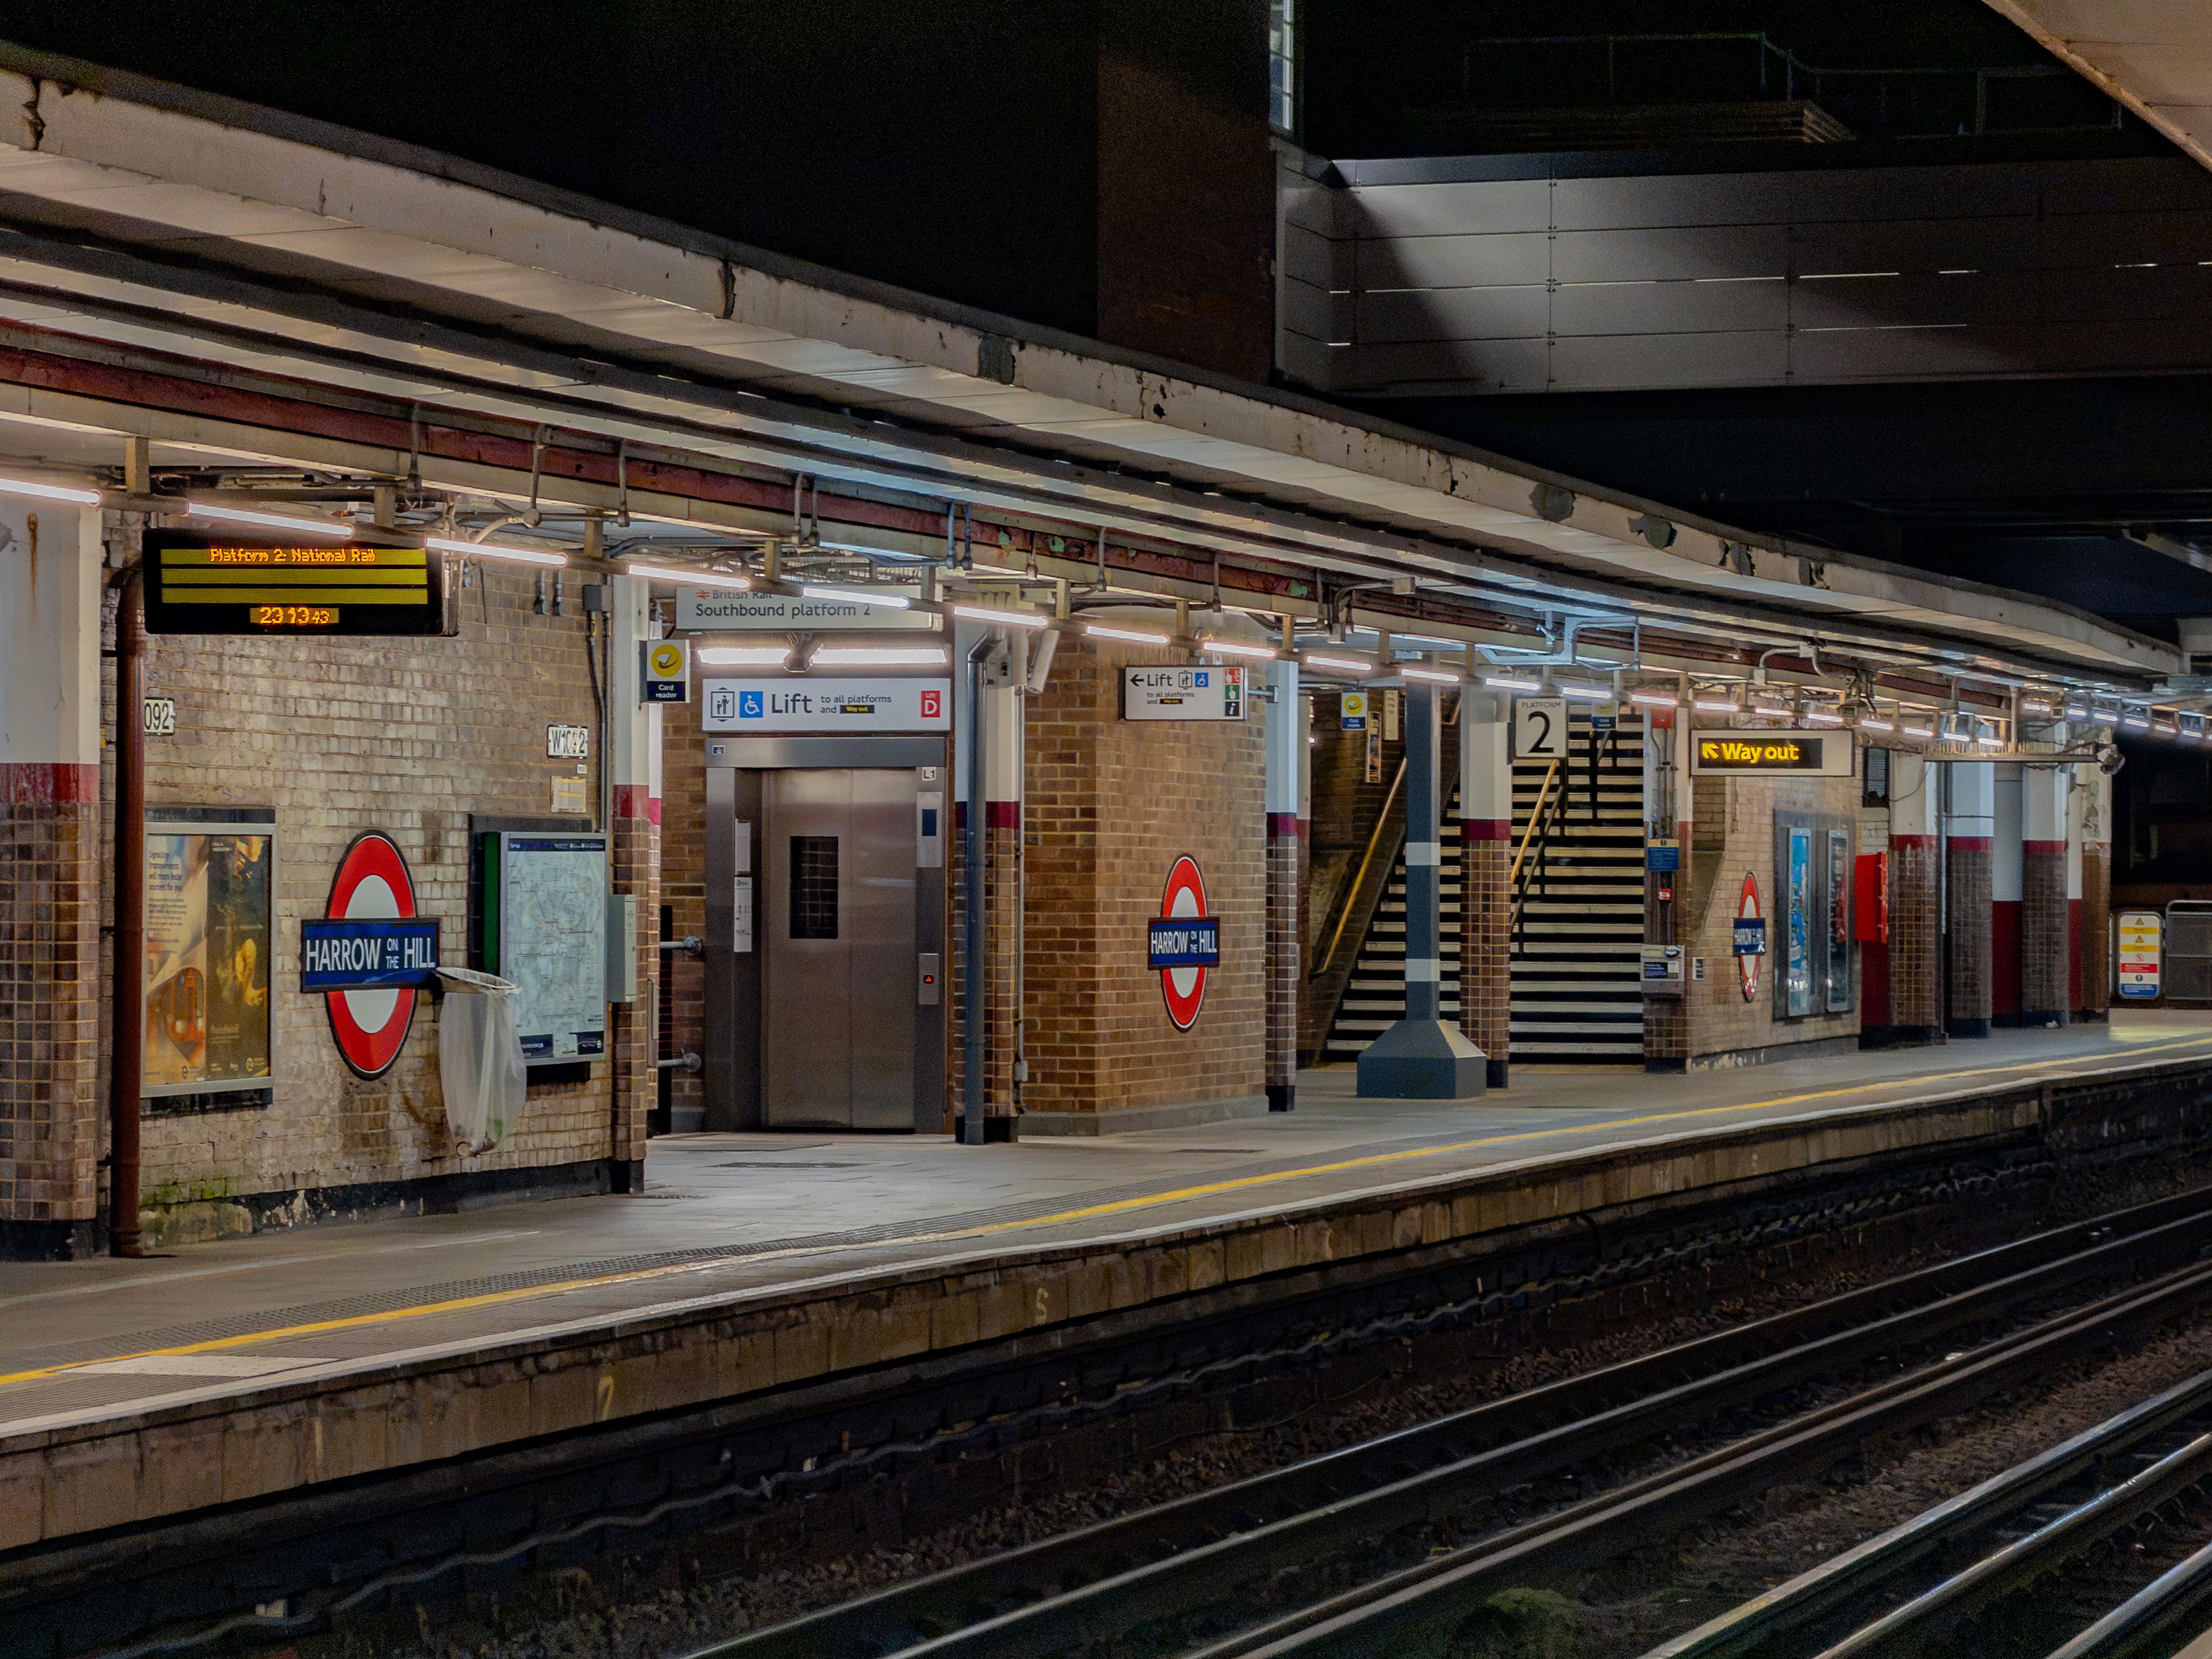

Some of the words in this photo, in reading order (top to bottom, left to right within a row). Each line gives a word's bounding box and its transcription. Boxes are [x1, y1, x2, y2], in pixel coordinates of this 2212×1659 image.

[210, 548, 269, 562] Platform
[274, 548, 287, 562] 2:
[291, 548, 346, 562] National
[351, 548, 375, 562] Rail
[713, 590, 747, 599] British
[696, 603, 784, 617] Southbound
[792, 604, 856, 619] platform
[863, 604, 871, 616] 2
[1147, 673, 1173, 686] Lift
[771, 693, 812, 713] Lift
[821, 695, 831, 703] to
[834, 695, 845, 703] all
[848, 695, 891, 705] platforms
[924, 699, 937, 714] D
[1527, 710, 1554, 753] 2
[1721, 743, 1762, 763] Way
[1764, 744, 1799, 760] out
[923, 769, 935, 779] L1
[386, 938, 399, 952] ON
[1151, 930, 1188, 954] HARROW
[1199, 930, 1217, 953] HILL
[306, 938, 382, 972] HARROW
[404, 937, 436, 969] HILL
[386, 956, 399, 969] THE
